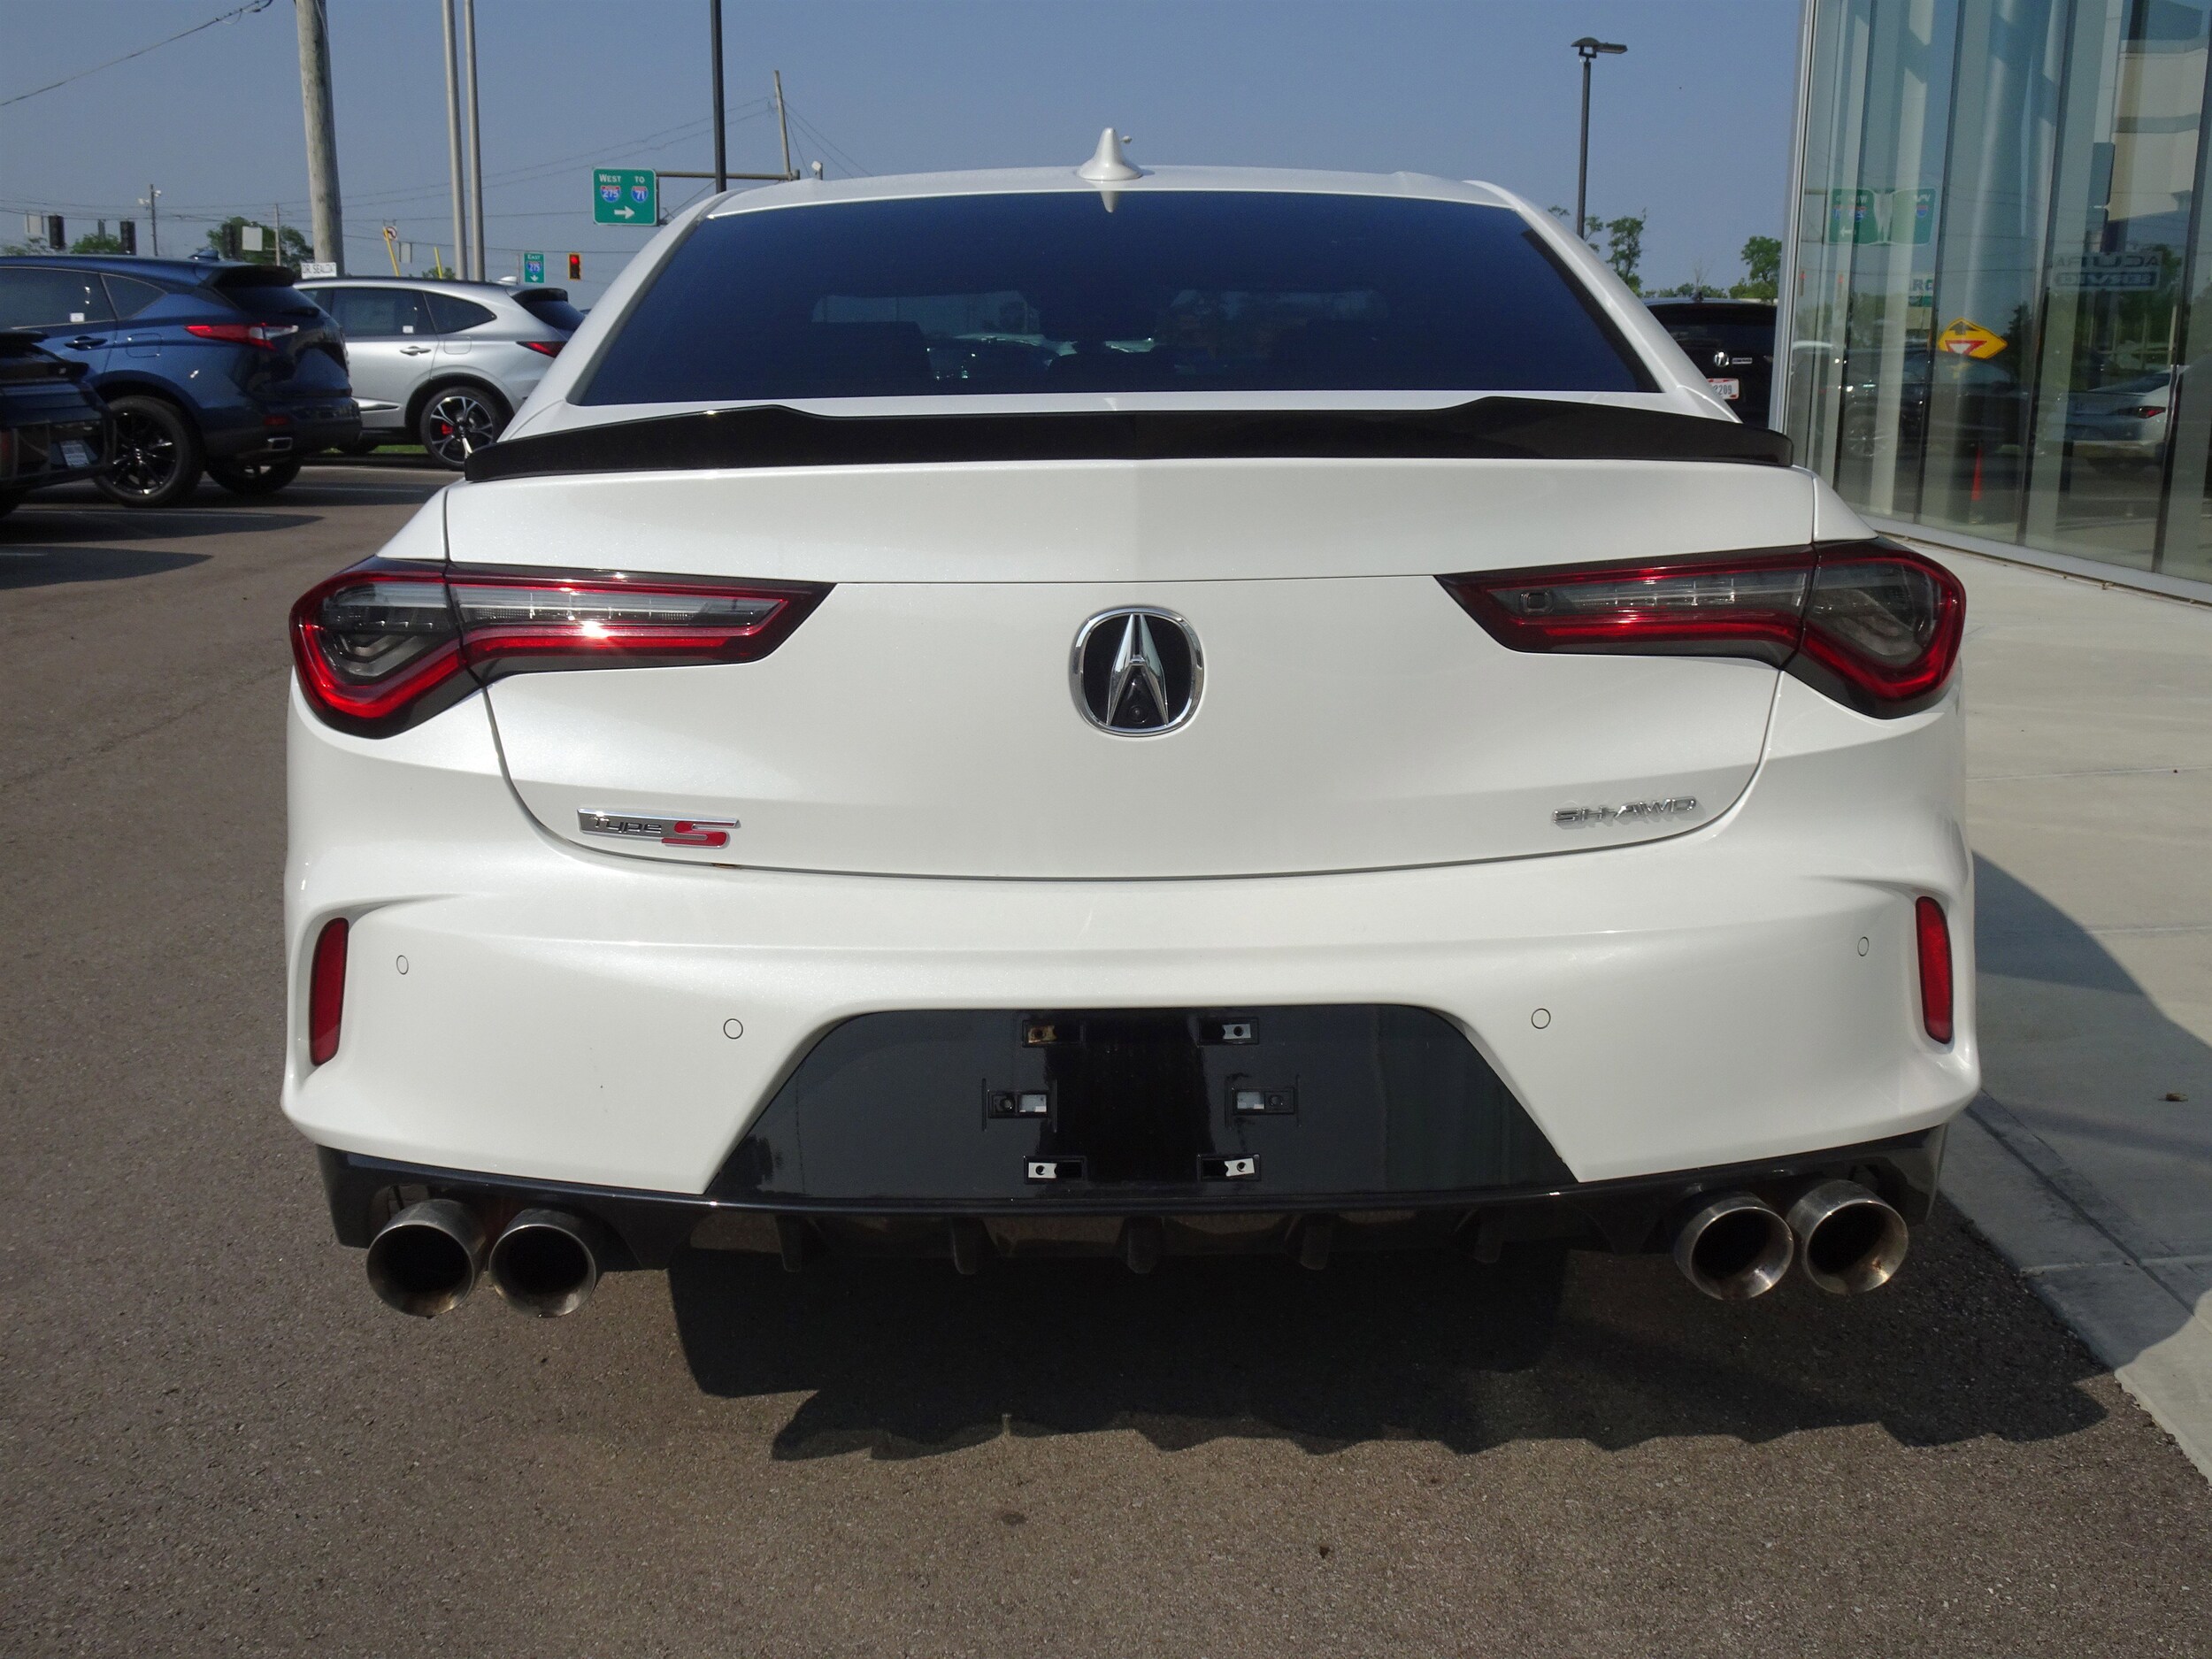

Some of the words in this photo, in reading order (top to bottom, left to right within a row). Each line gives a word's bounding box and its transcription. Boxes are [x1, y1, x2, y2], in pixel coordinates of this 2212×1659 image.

[599, 173, 621, 183] WEST
[634, 175, 646, 184] TO
[603, 189, 619, 198] 275
[636, 189, 645, 200] 71
[529, 263, 541, 272] 275
[1551, 796, 1697, 823] SH-AWD
[662, 819, 740, 848] S
